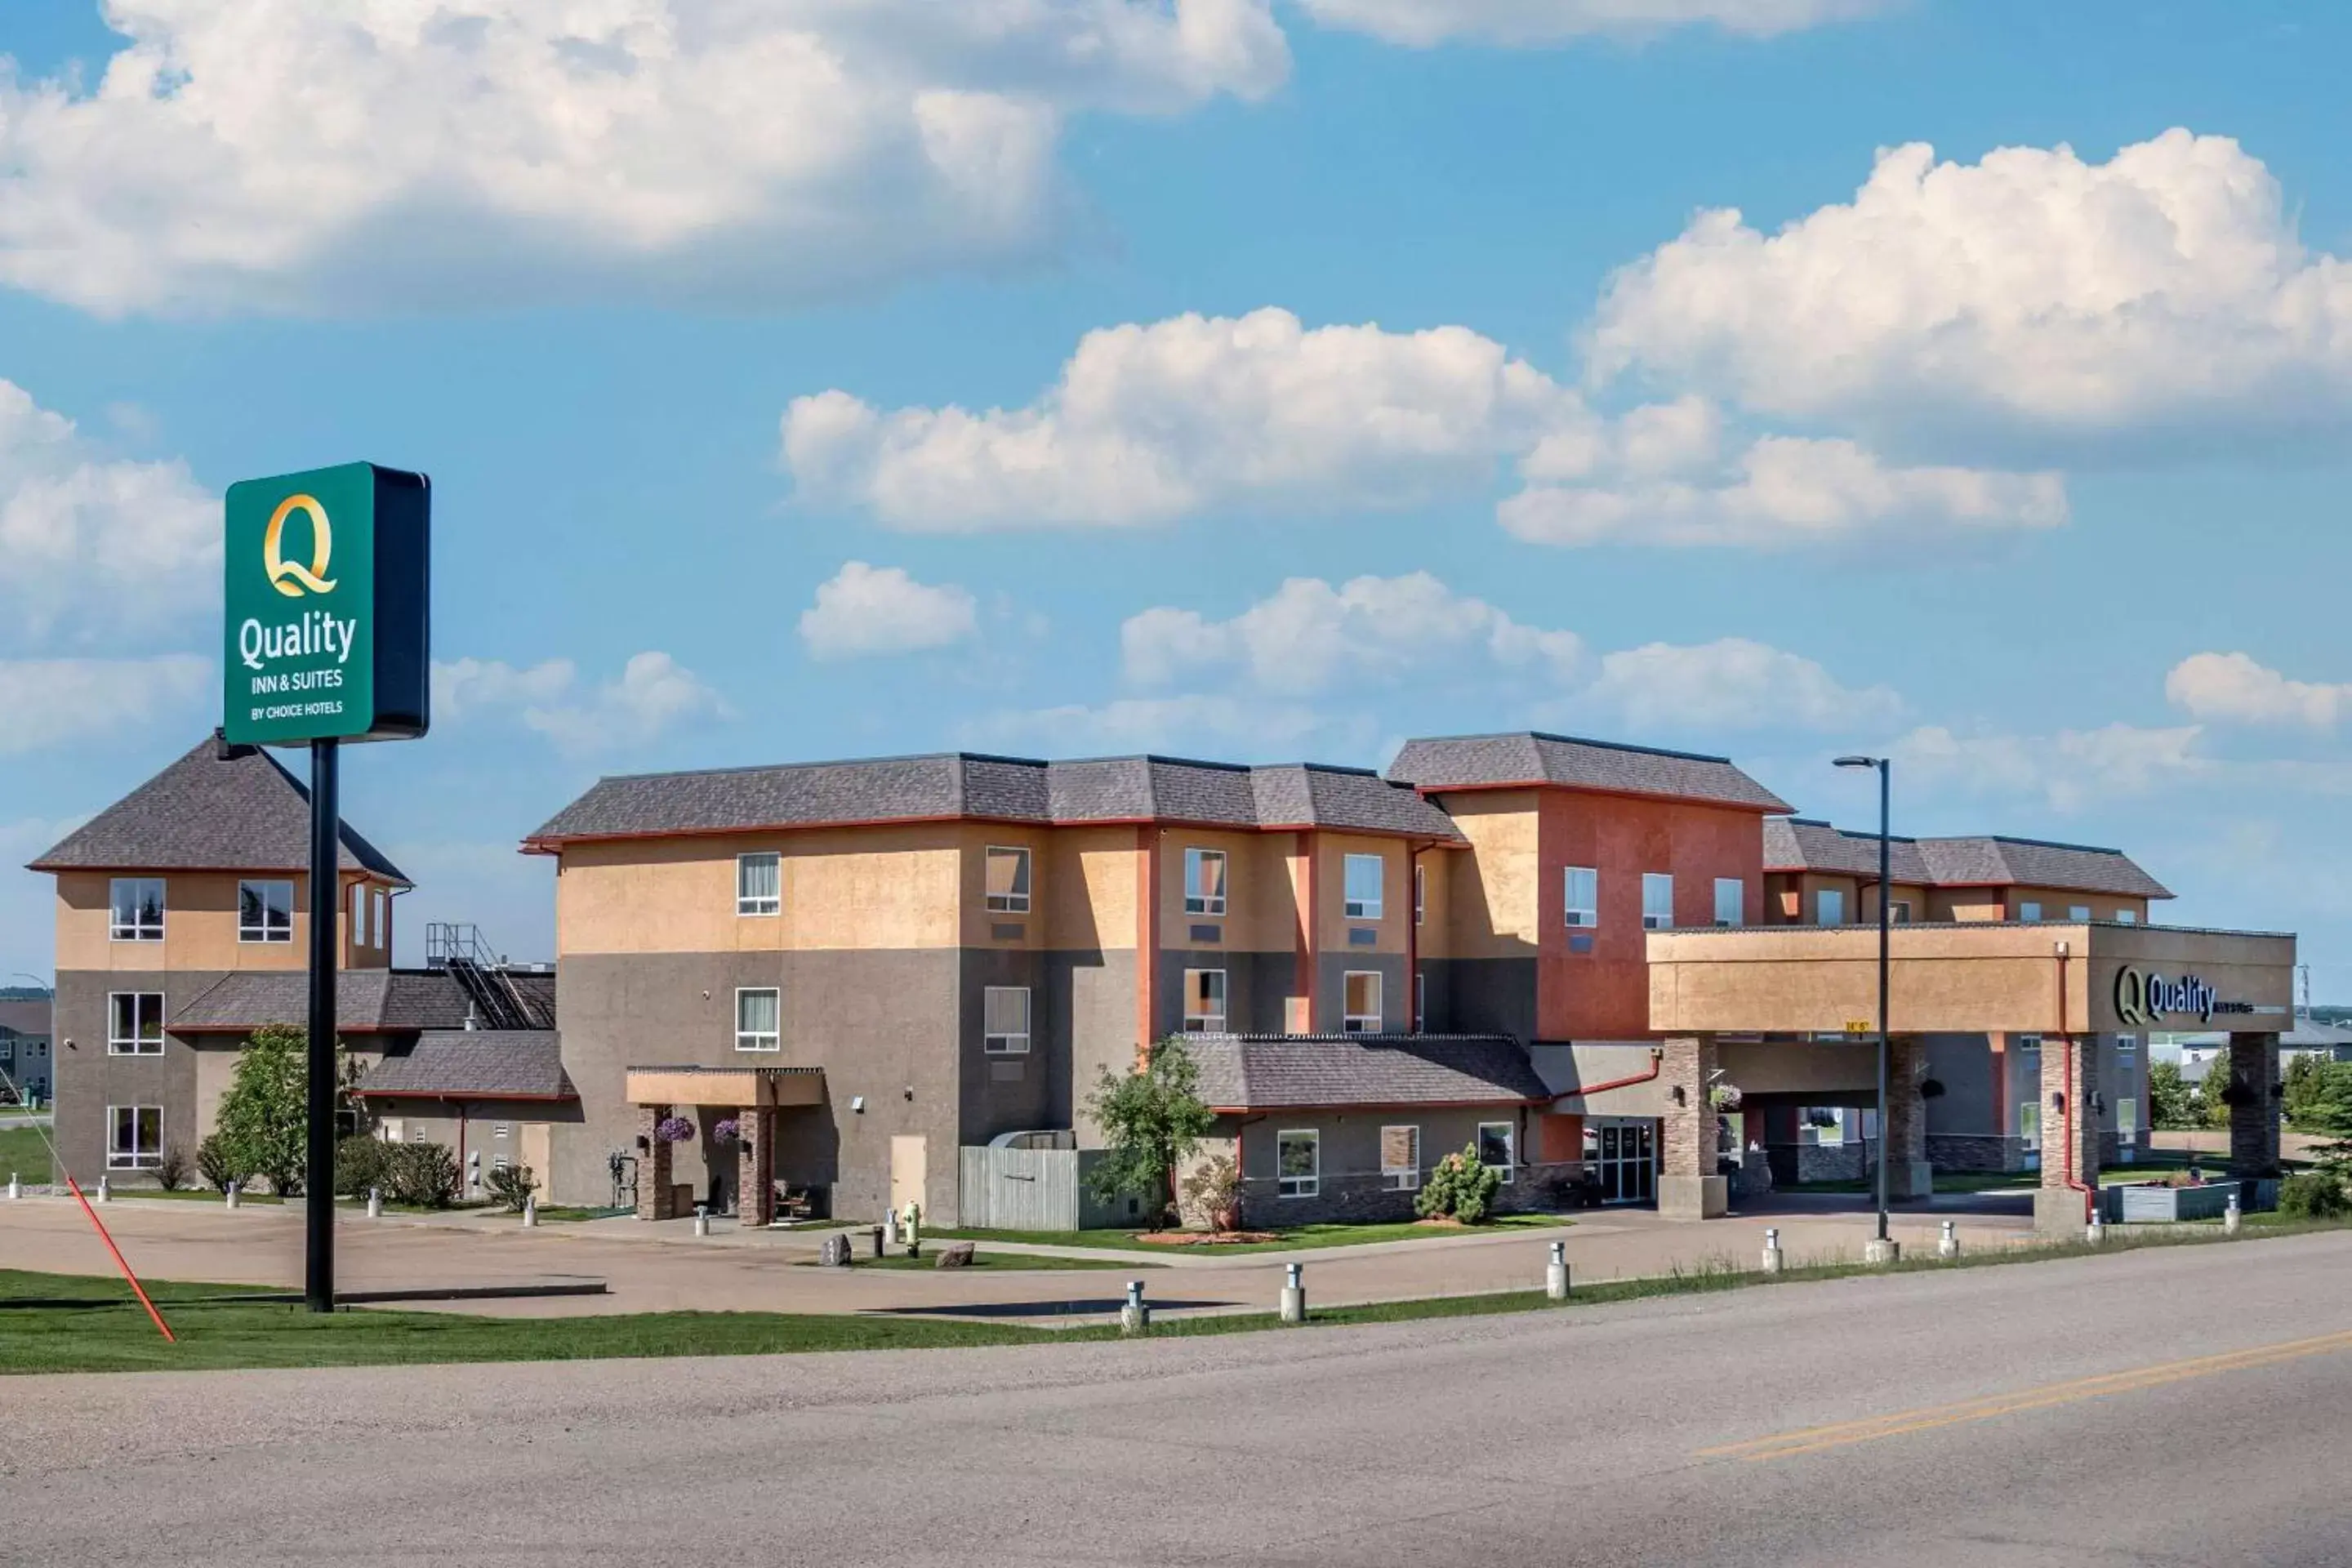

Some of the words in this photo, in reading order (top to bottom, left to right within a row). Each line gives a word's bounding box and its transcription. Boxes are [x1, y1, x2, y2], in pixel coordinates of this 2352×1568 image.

[264, 492, 337, 597] Q
[239, 610, 356, 670] Quality
[251, 707, 264, 720] BY
[265, 704, 303, 719] CHOICE
[305, 701, 343, 716] HOTELS
[252, 675, 278, 695] INN
[279, 674, 289, 691] &
[292, 669, 343, 691] SUITES
[2114, 964, 2146, 1026] Q
[2145, 973, 2216, 1024] Quality
